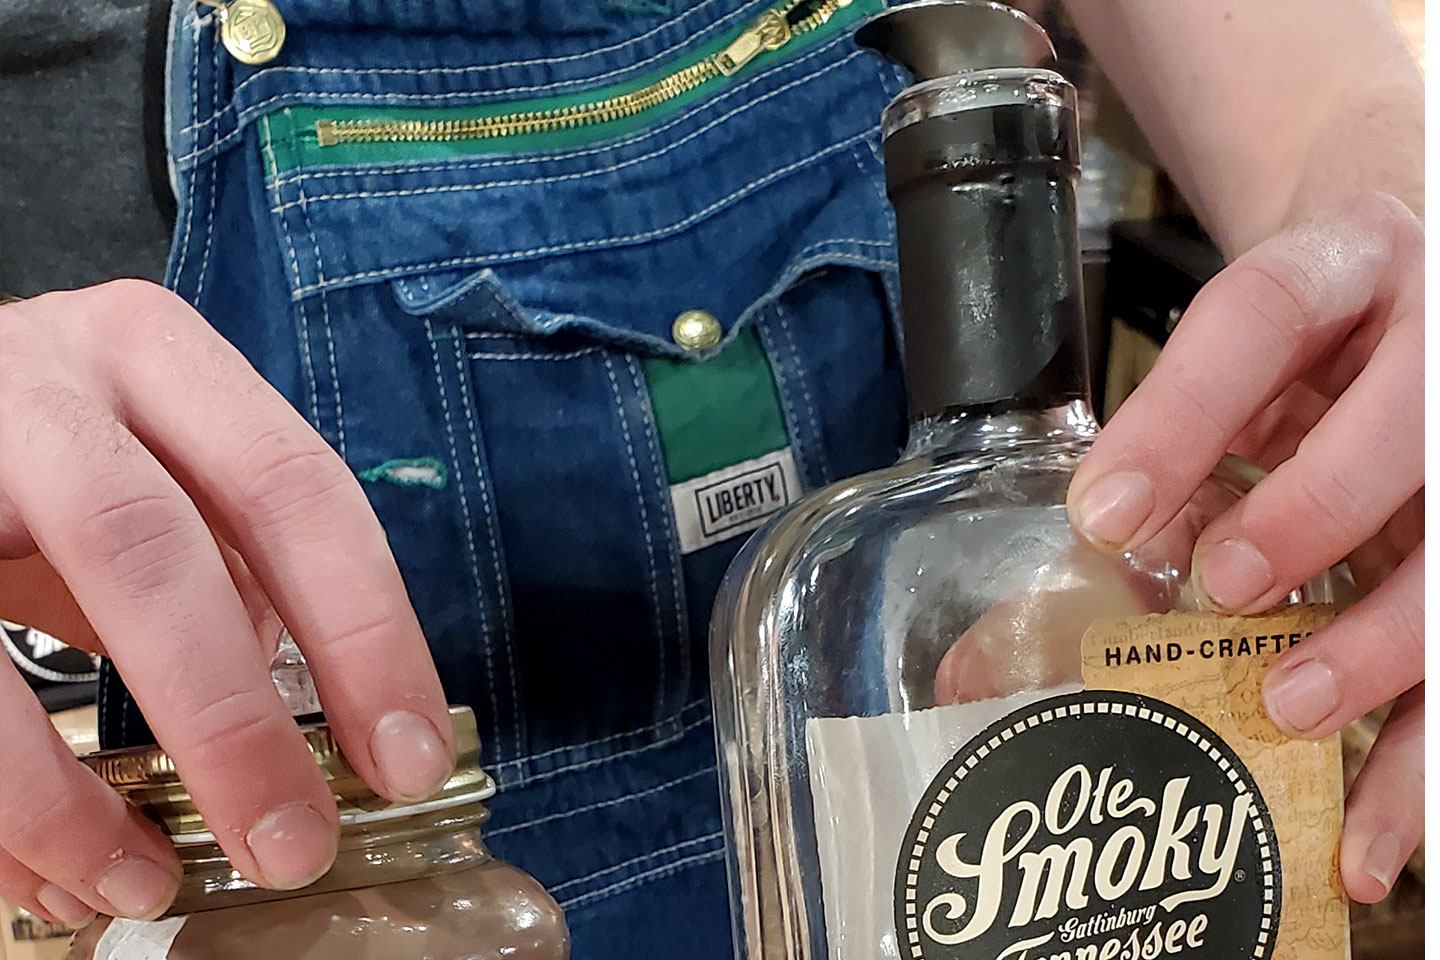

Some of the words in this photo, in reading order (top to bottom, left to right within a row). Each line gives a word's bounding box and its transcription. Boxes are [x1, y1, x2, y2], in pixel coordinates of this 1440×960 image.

[705, 473, 776, 524] LIBERTY
[1105, 631, 1313, 667] HAND-CRAFTE
[1045, 764, 1156, 835] Ole
[922, 776, 1253, 945] Smoky
[1058, 904, 1158, 943] Gatlinburg
